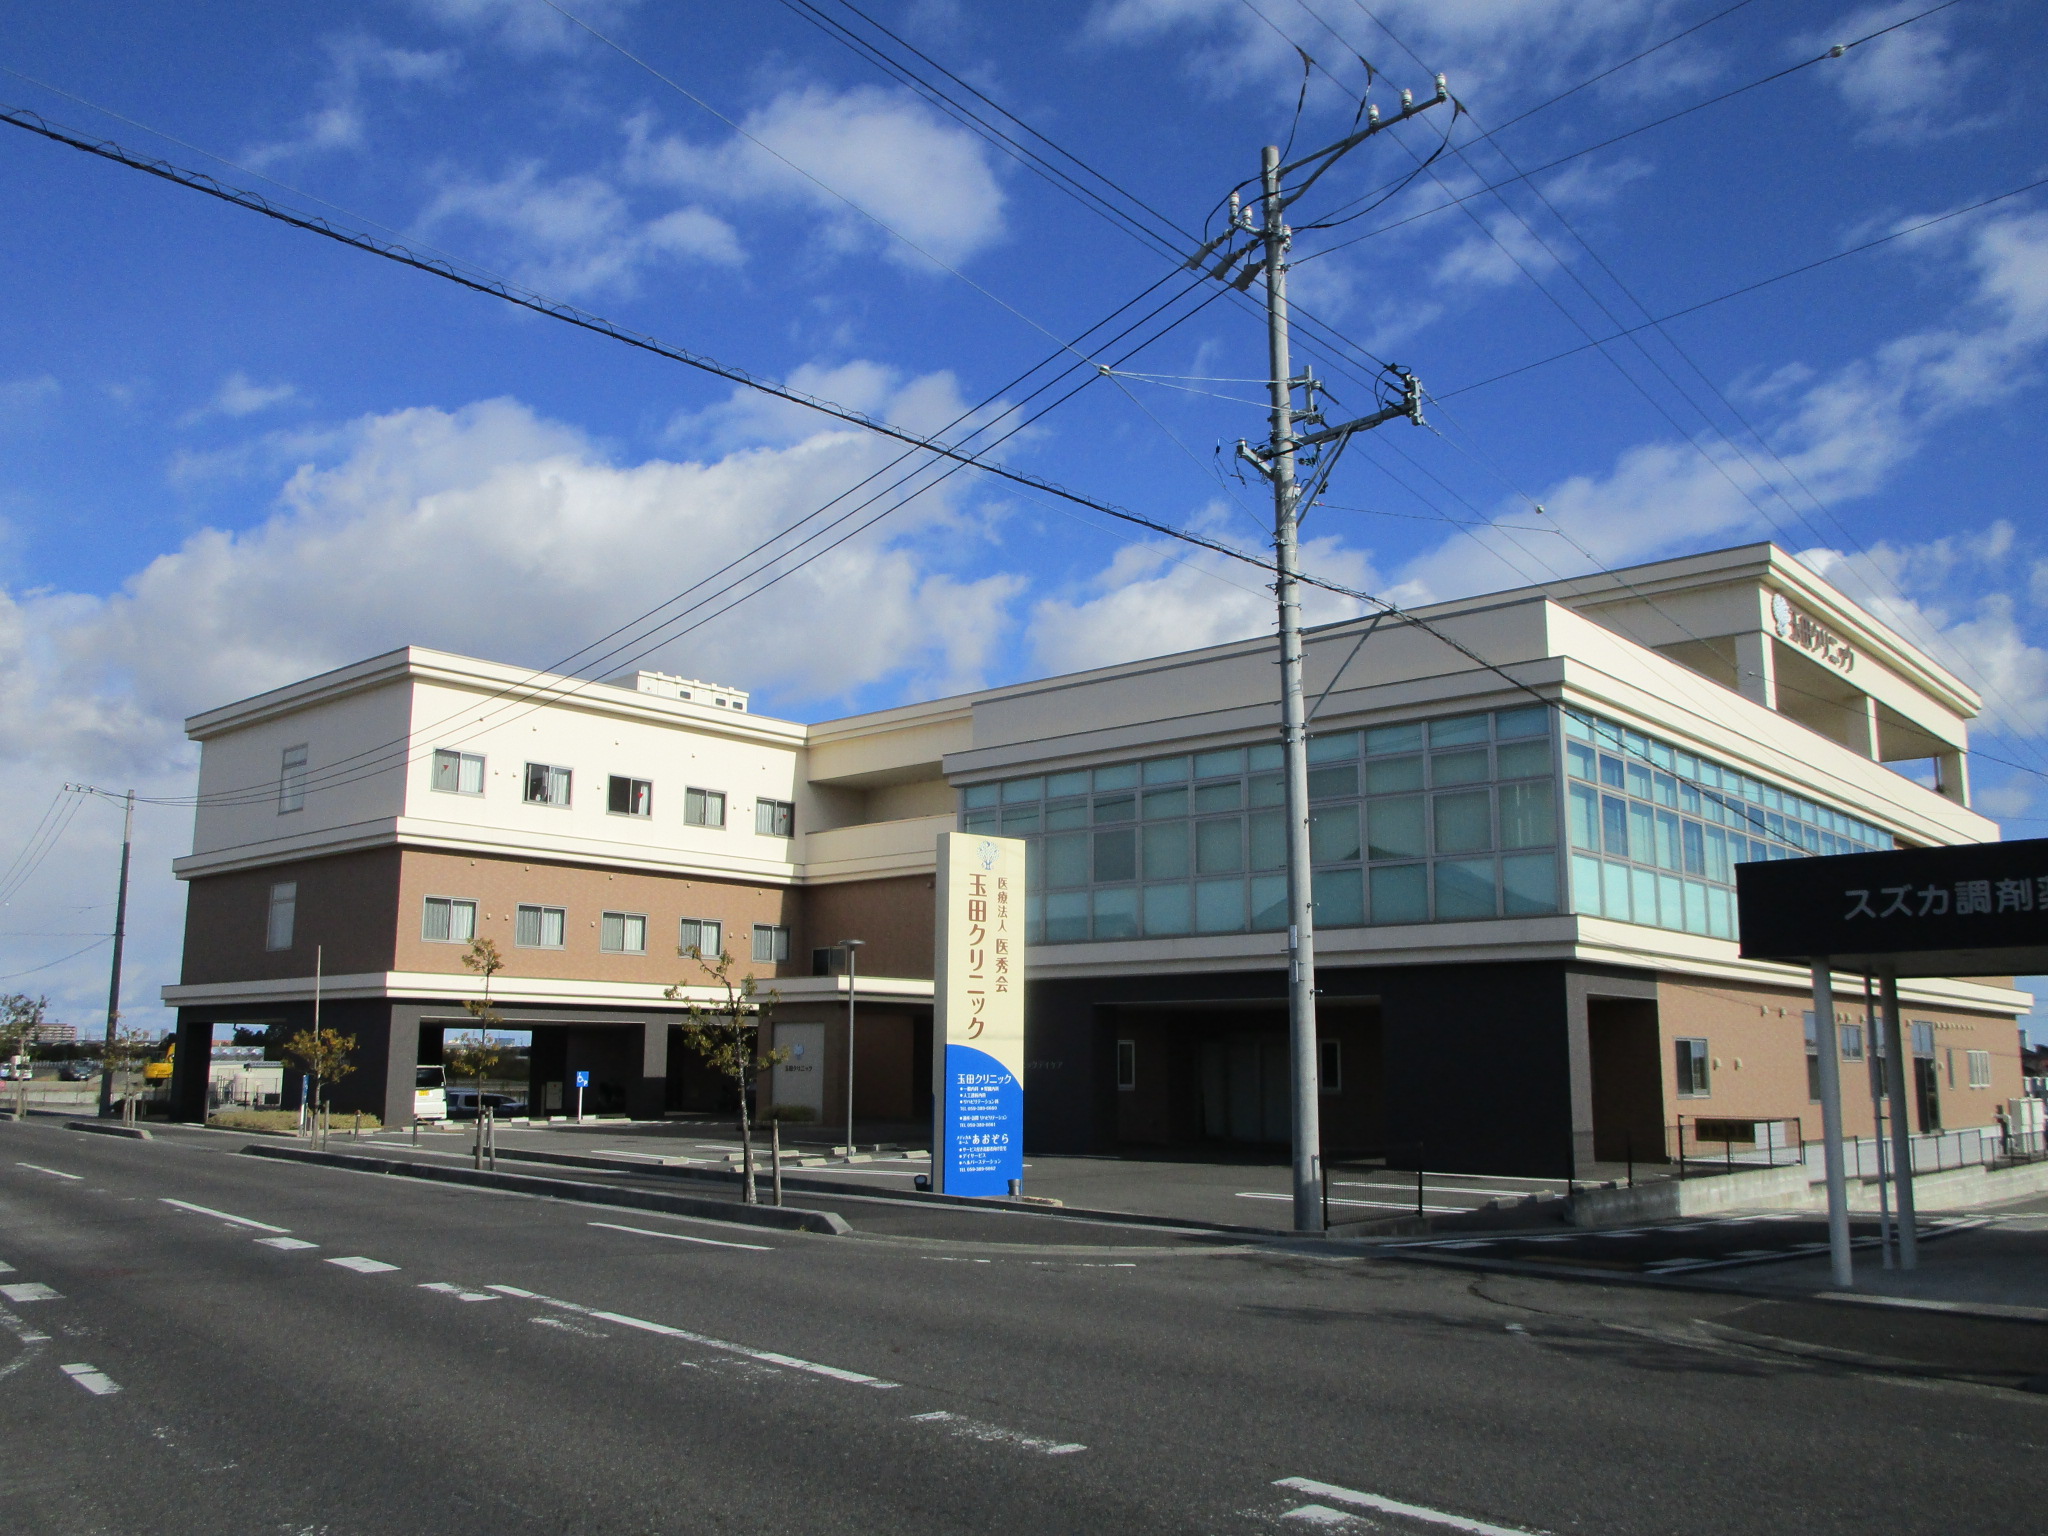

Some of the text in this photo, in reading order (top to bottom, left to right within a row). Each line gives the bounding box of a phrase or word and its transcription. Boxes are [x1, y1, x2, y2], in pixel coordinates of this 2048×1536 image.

[967, 873, 988, 1040] 玉田クリニック
[995, 876, 1009, 993] 医療法人 医秀会
[957, 1073, 1012, 1085] 玉田クリニック
[972, 1133, 1009, 1145] あおぞら
